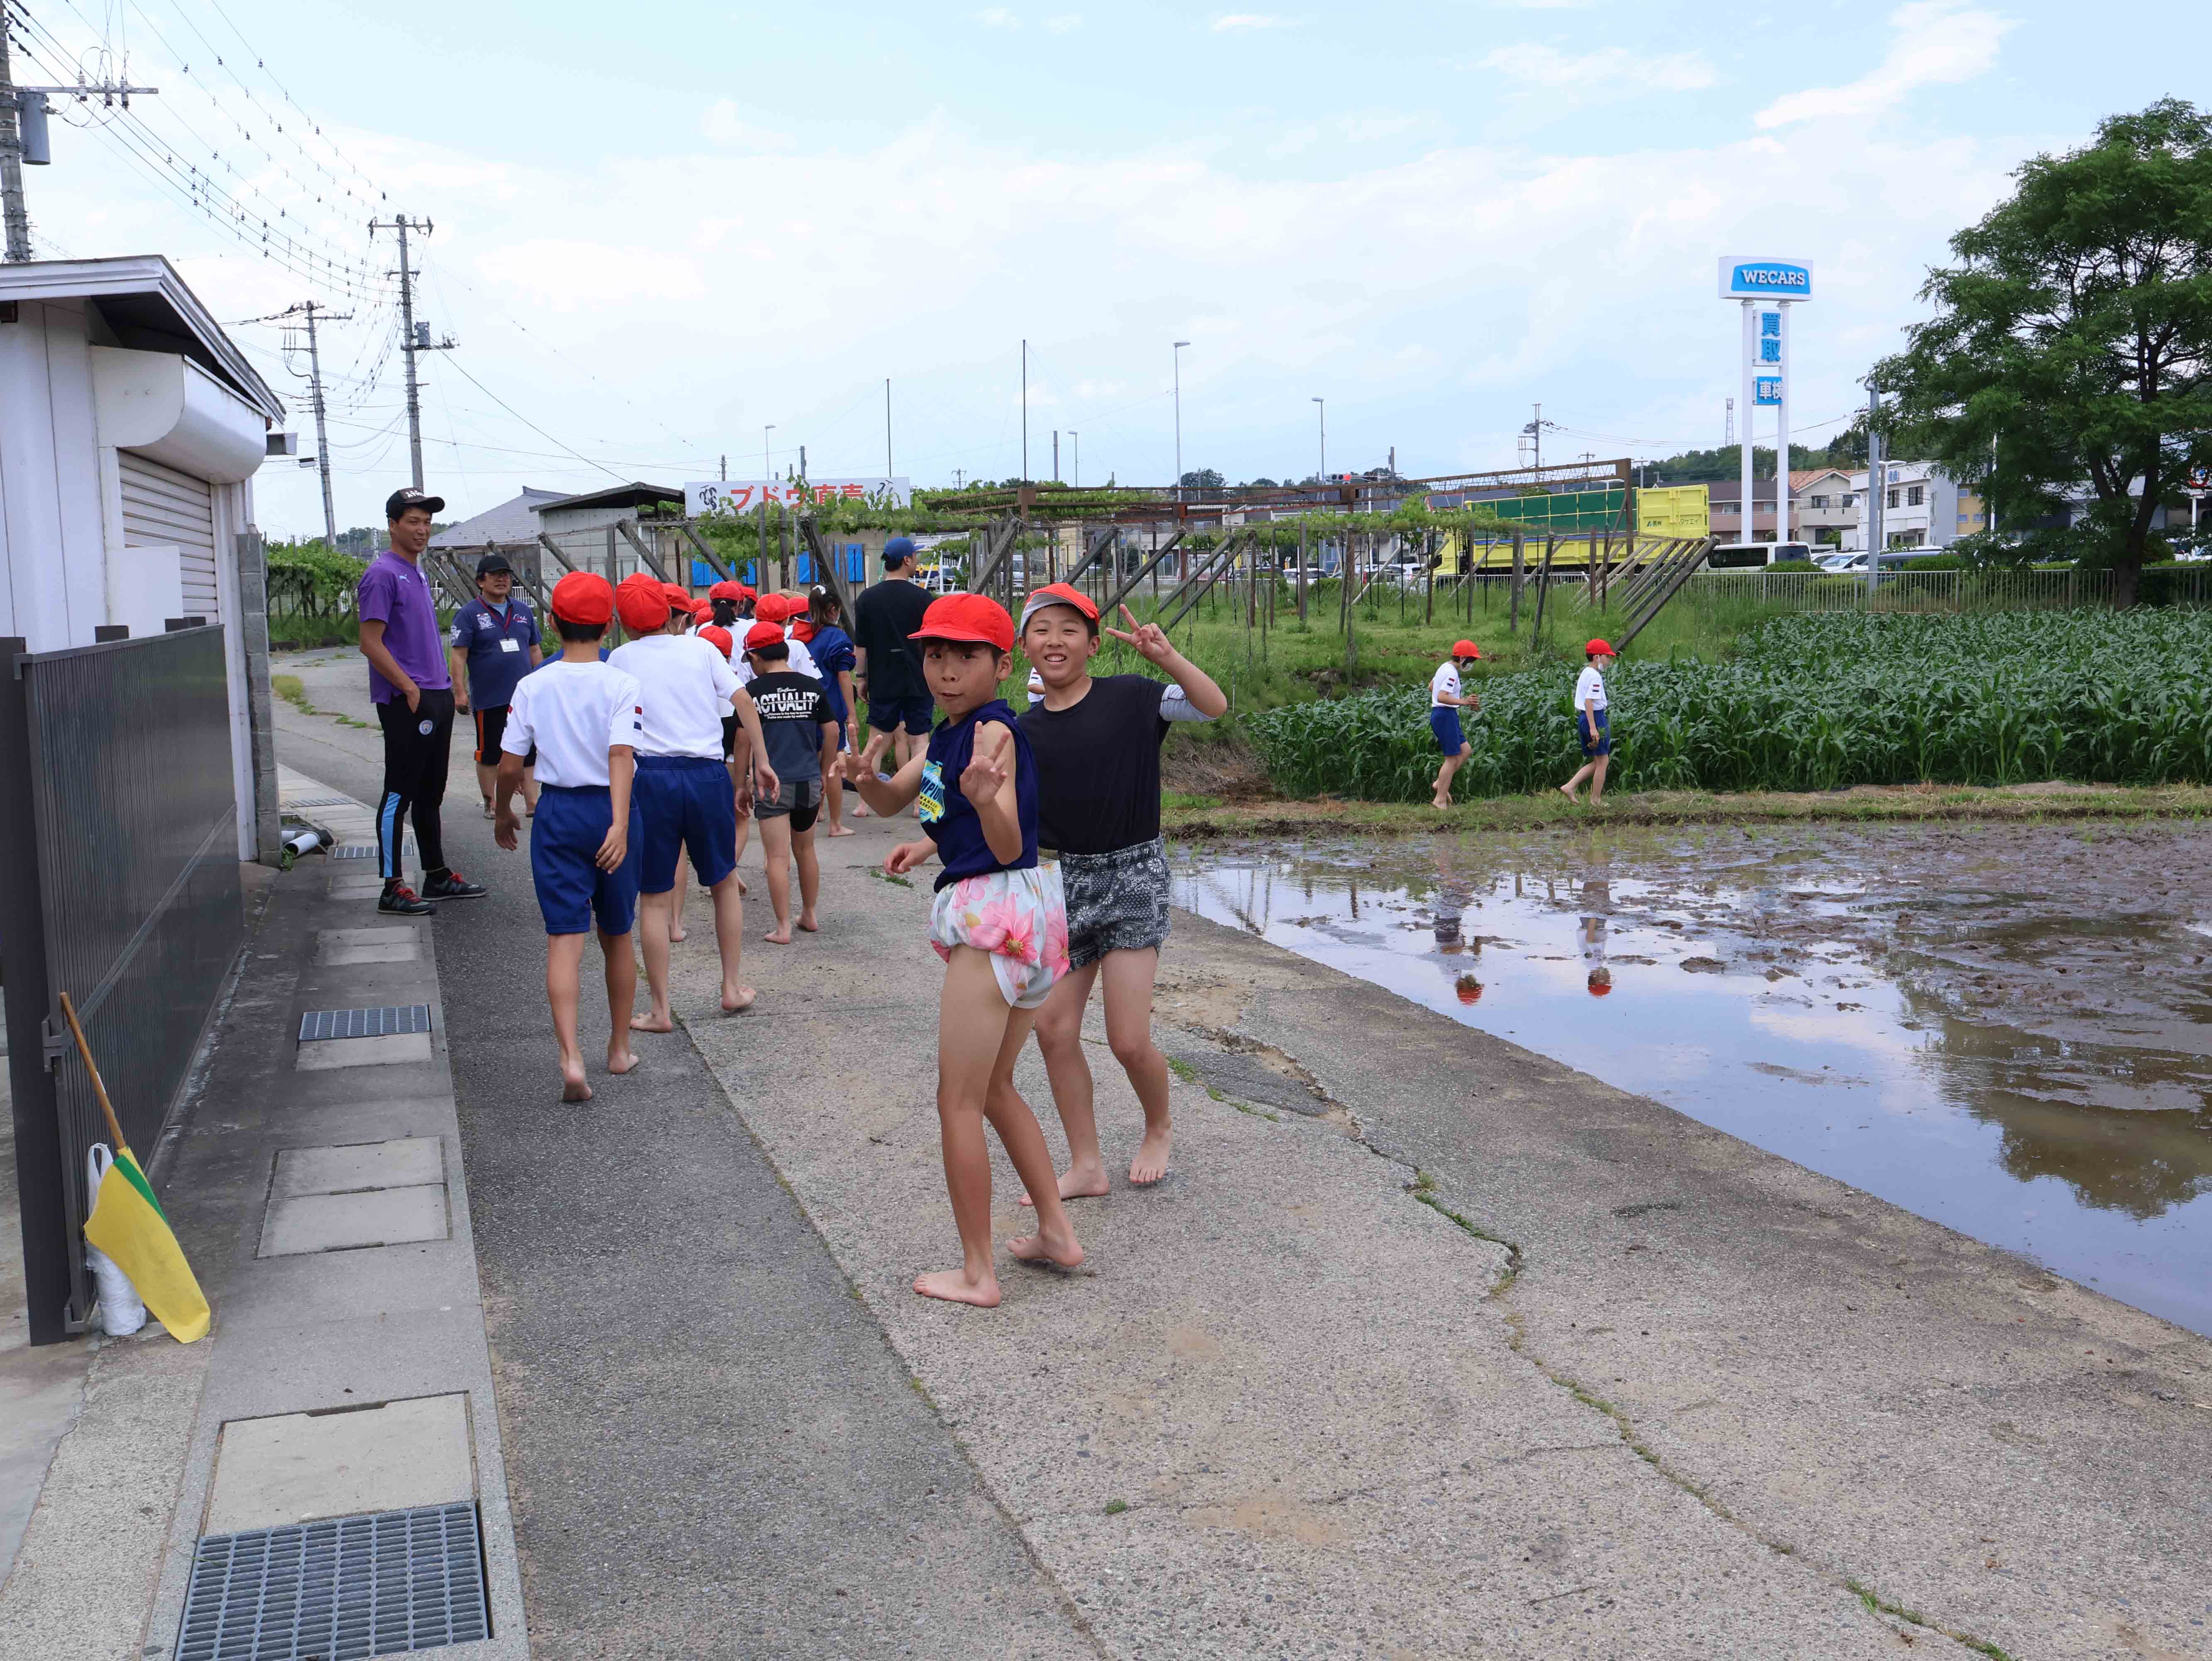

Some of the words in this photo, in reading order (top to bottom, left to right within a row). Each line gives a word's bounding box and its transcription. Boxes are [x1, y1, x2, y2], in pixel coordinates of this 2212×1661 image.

[1742, 269, 1806, 286] WECARS
[1761, 312, 1781, 362] 買取
[753, 692, 820, 714] ACTUALITY
